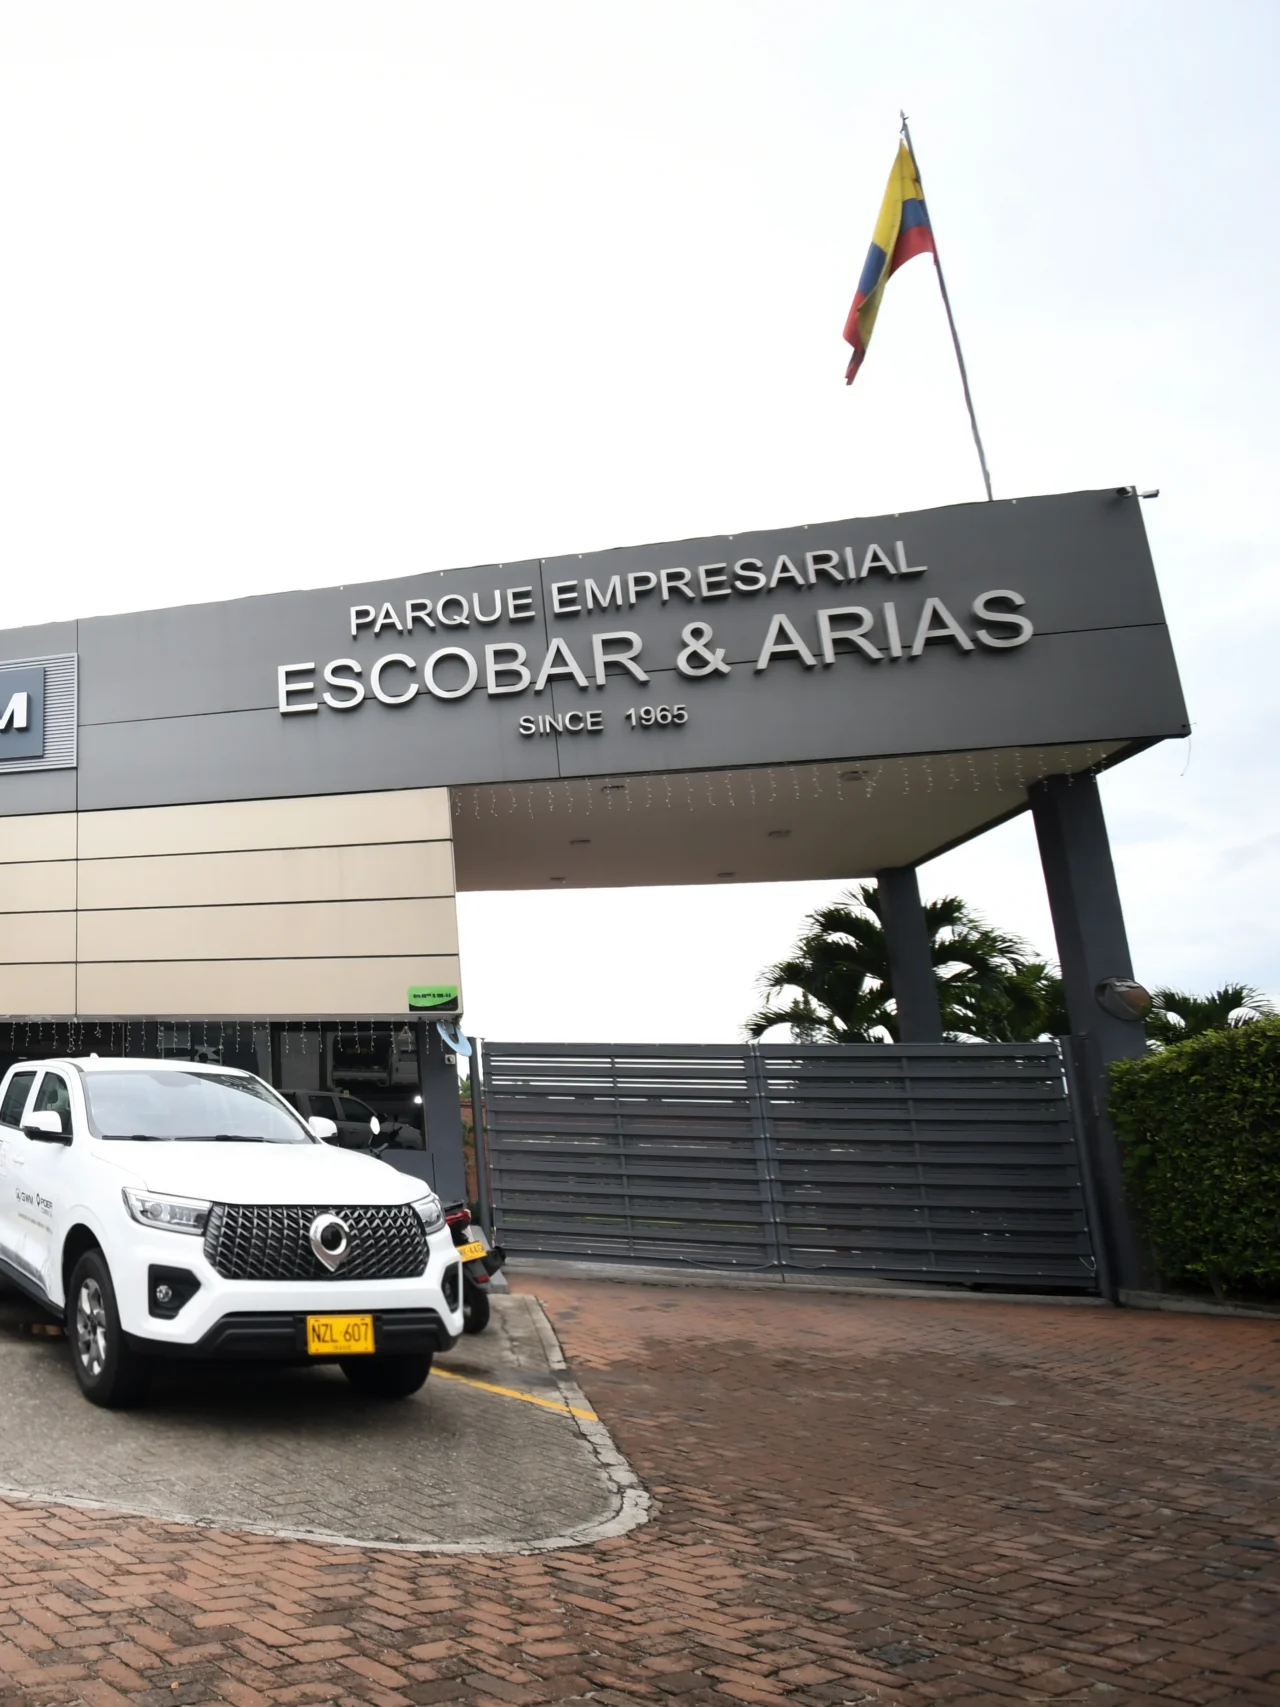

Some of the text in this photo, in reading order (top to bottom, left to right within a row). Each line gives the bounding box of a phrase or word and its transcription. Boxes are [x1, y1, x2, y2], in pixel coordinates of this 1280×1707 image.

[349, 540, 928, 638] PARQUE EMPRESARIAL
[277, 588, 1035, 715] ESCOBAR & ARIAS
[518, 703, 690, 737] SINCE 1965
[311, 1322, 369, 1343] NZL 607
